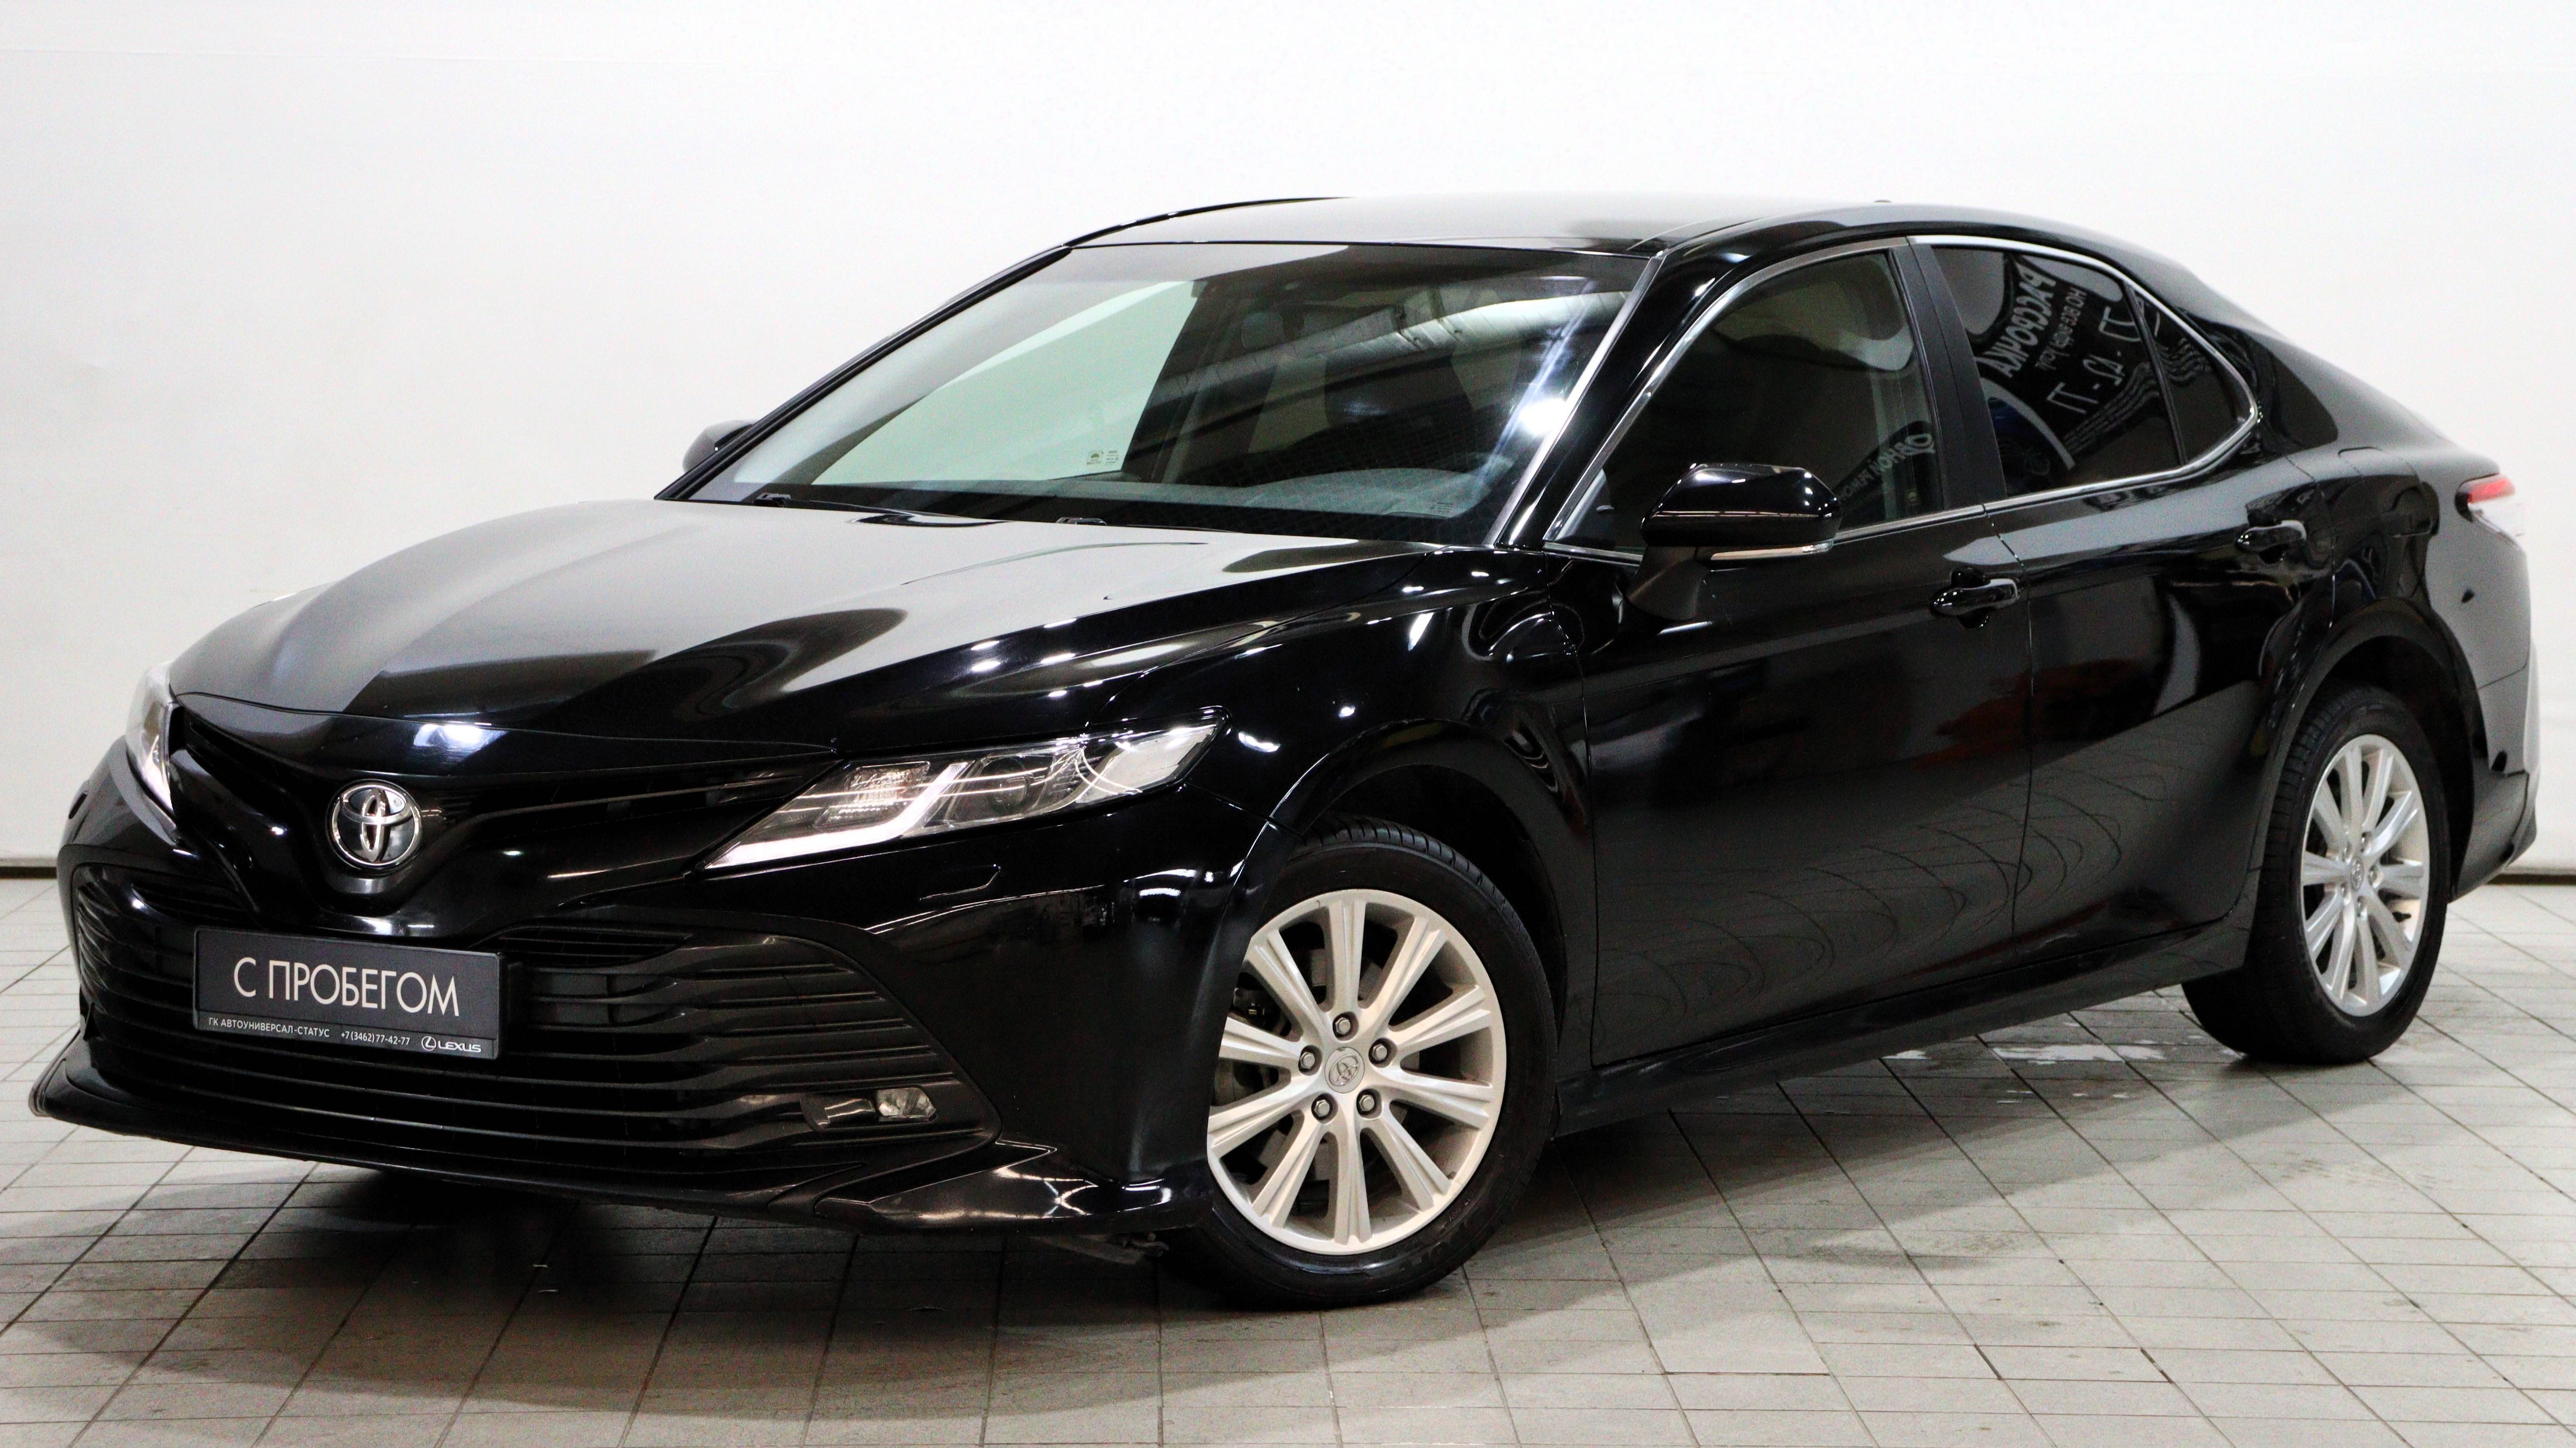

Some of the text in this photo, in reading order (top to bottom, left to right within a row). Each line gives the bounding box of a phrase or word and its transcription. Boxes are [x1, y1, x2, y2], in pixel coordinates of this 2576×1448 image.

[234, 957, 460, 1016] С ПРОБЕГОМ
[209, 1017, 219, 1026] ГК
[221, 1019, 330, 1037] АВТОУНИВЕРСАЛ-СТАТУС
[438, 1040, 482, 1053] LEXUS
